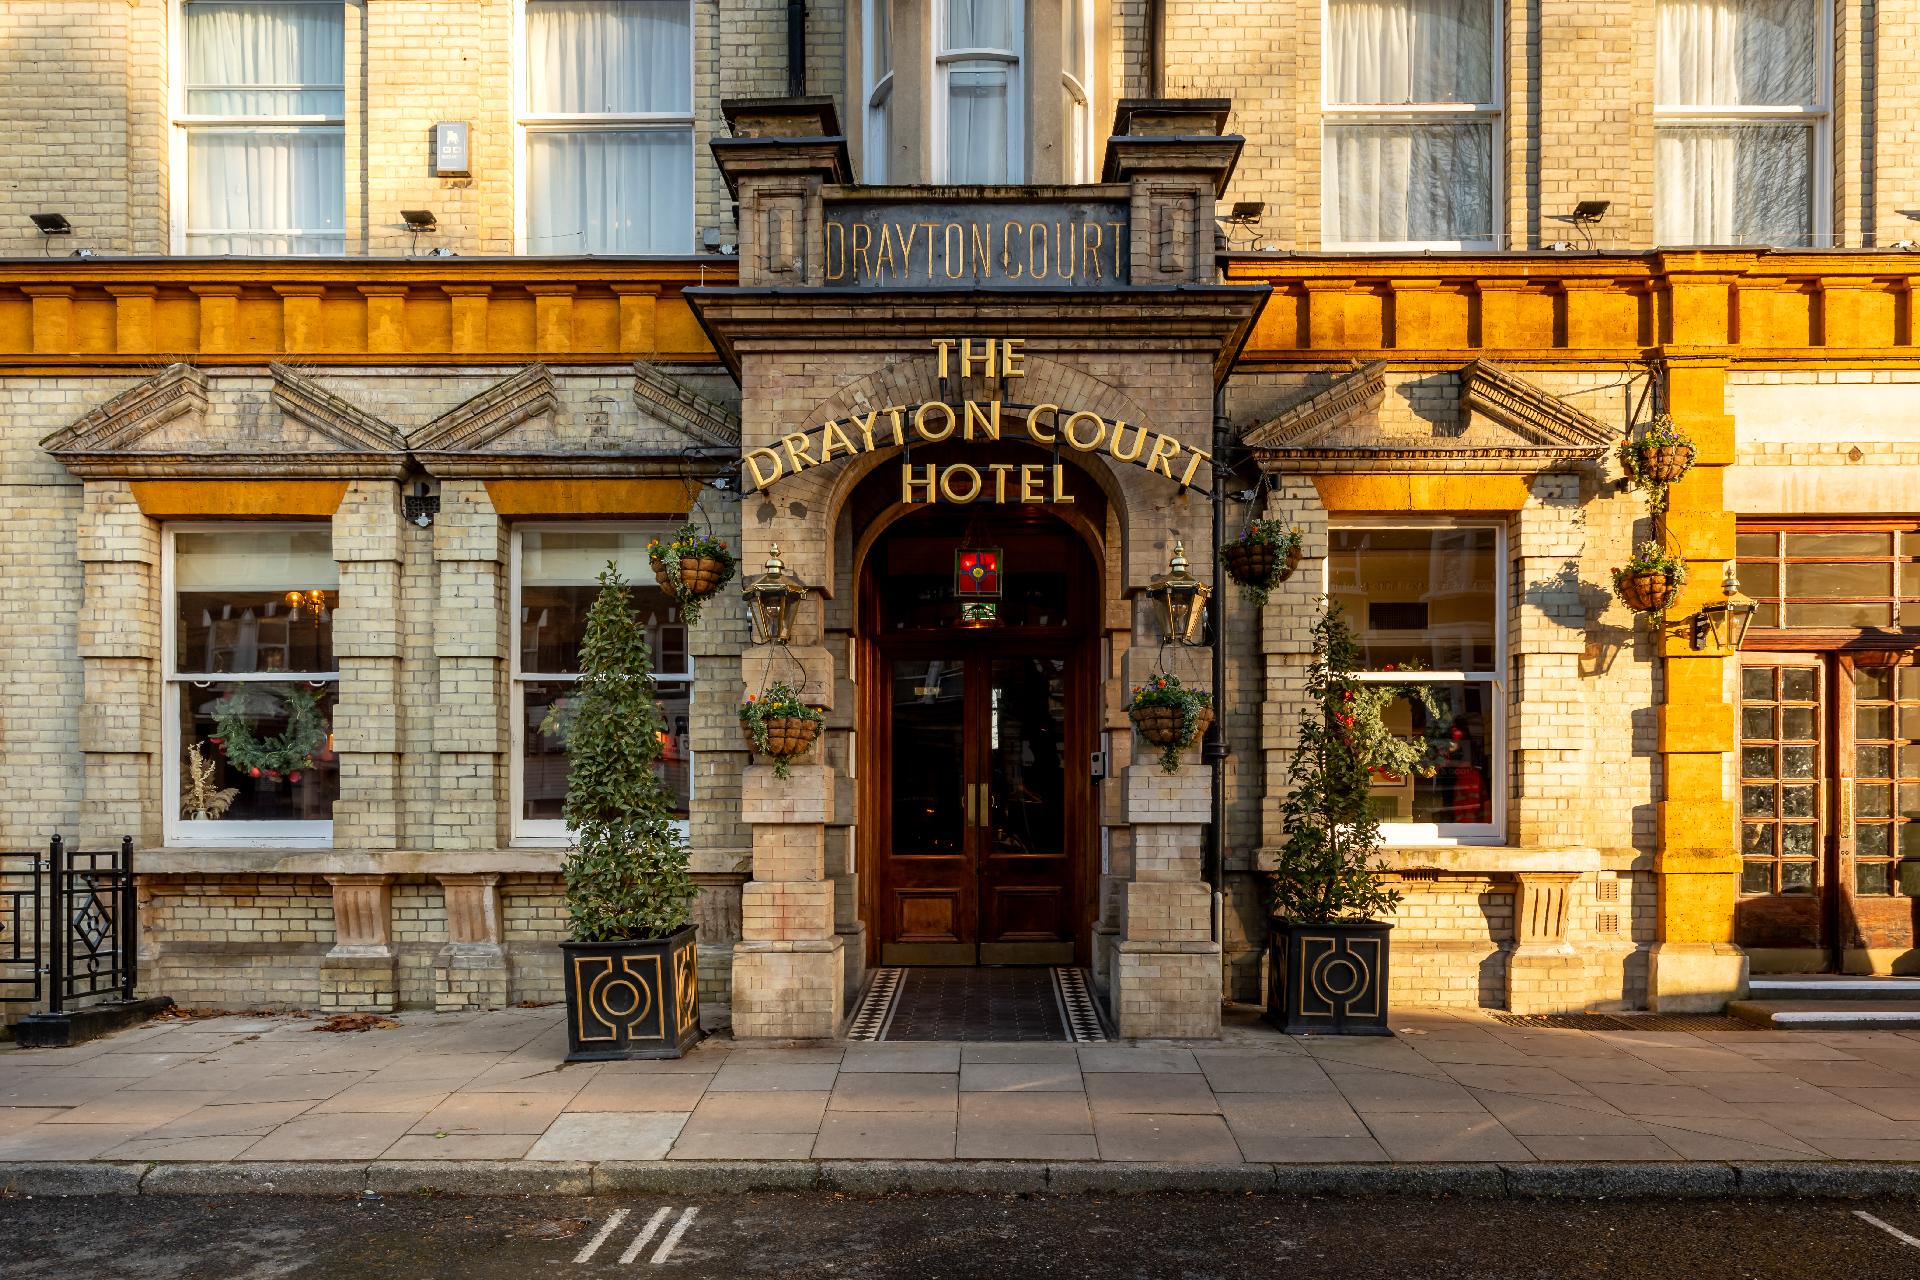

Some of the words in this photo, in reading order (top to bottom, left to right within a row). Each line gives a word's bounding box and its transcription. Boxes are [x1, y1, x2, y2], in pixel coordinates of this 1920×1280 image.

[826, 222, 990, 280] DRAYTON
[1004, 221, 1126, 279] COURT
[931, 338, 1025, 378] THE
[745, 400, 1000, 490] DRAYTON
[1027, 403, 1212, 486] COURT
[902, 463, 1075, 504] HOTEL
